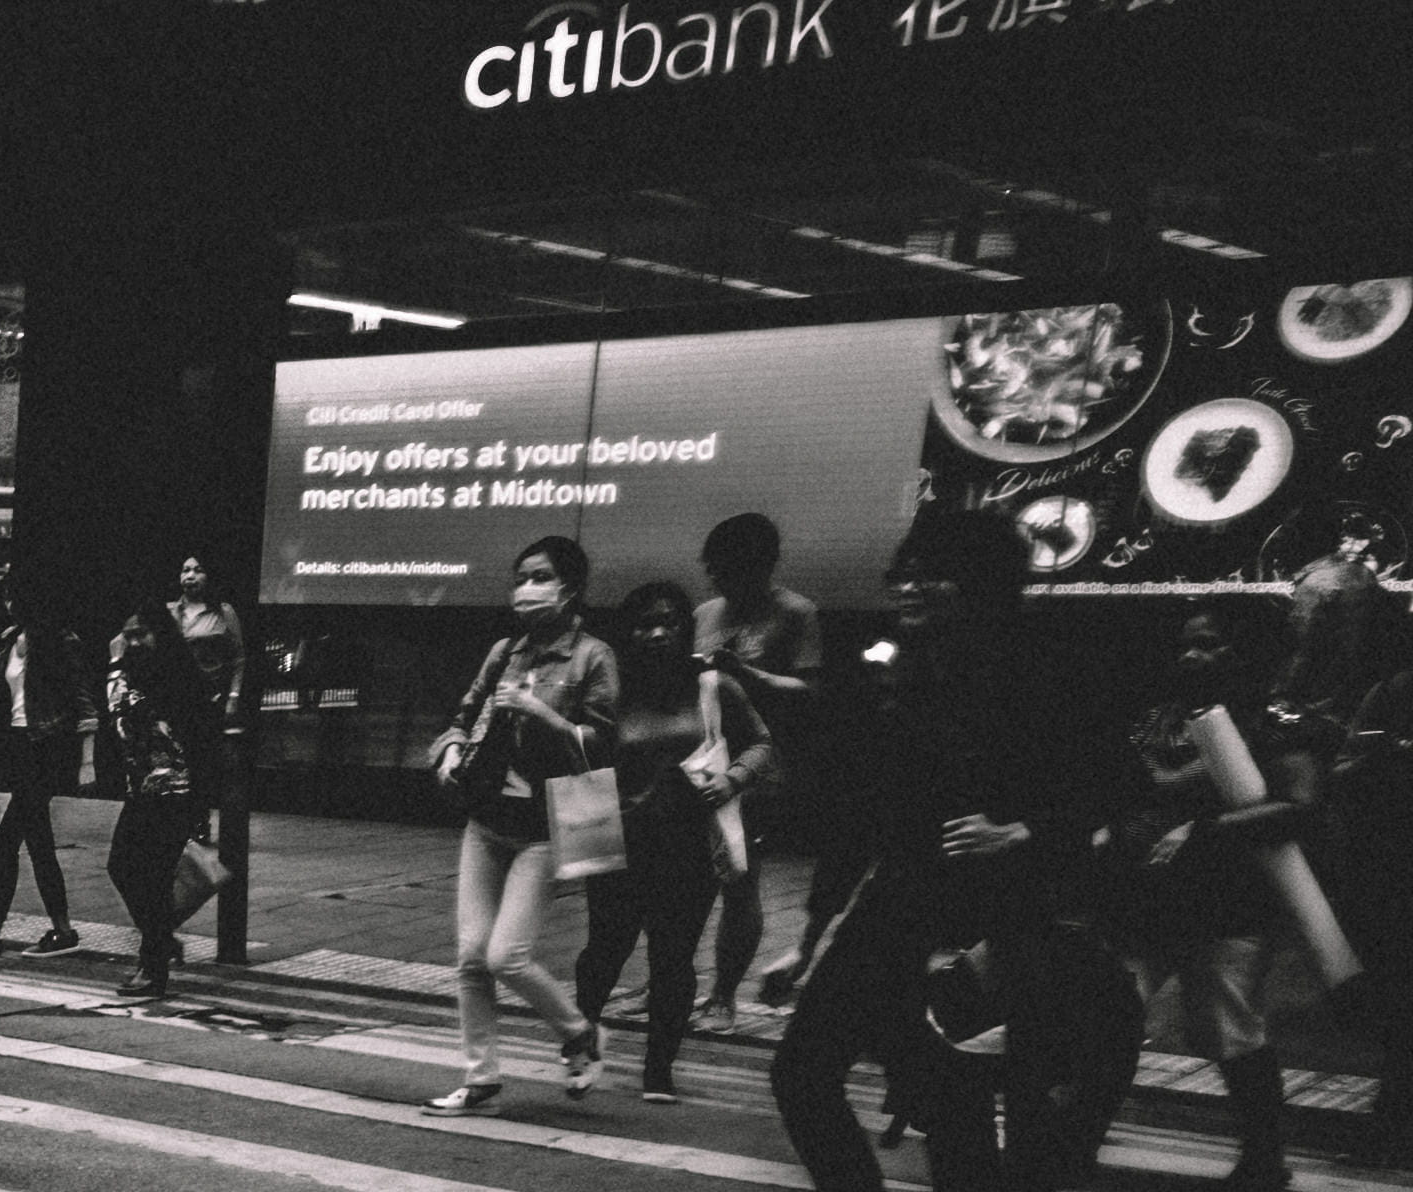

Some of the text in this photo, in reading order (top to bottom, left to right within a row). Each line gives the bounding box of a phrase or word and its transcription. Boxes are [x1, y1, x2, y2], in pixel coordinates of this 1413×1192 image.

[464, 0, 833, 109] citibank
[306, 401, 485, 425] Citi Credit Card Offer
[304, 432, 718, 478] Enjoy offers at your beloved
[301, 478, 617, 511] merchants at Midtown
[295, 560, 469, 576] Details: citibank.hk/midtown
[1052, 581, 1111, 595] available
